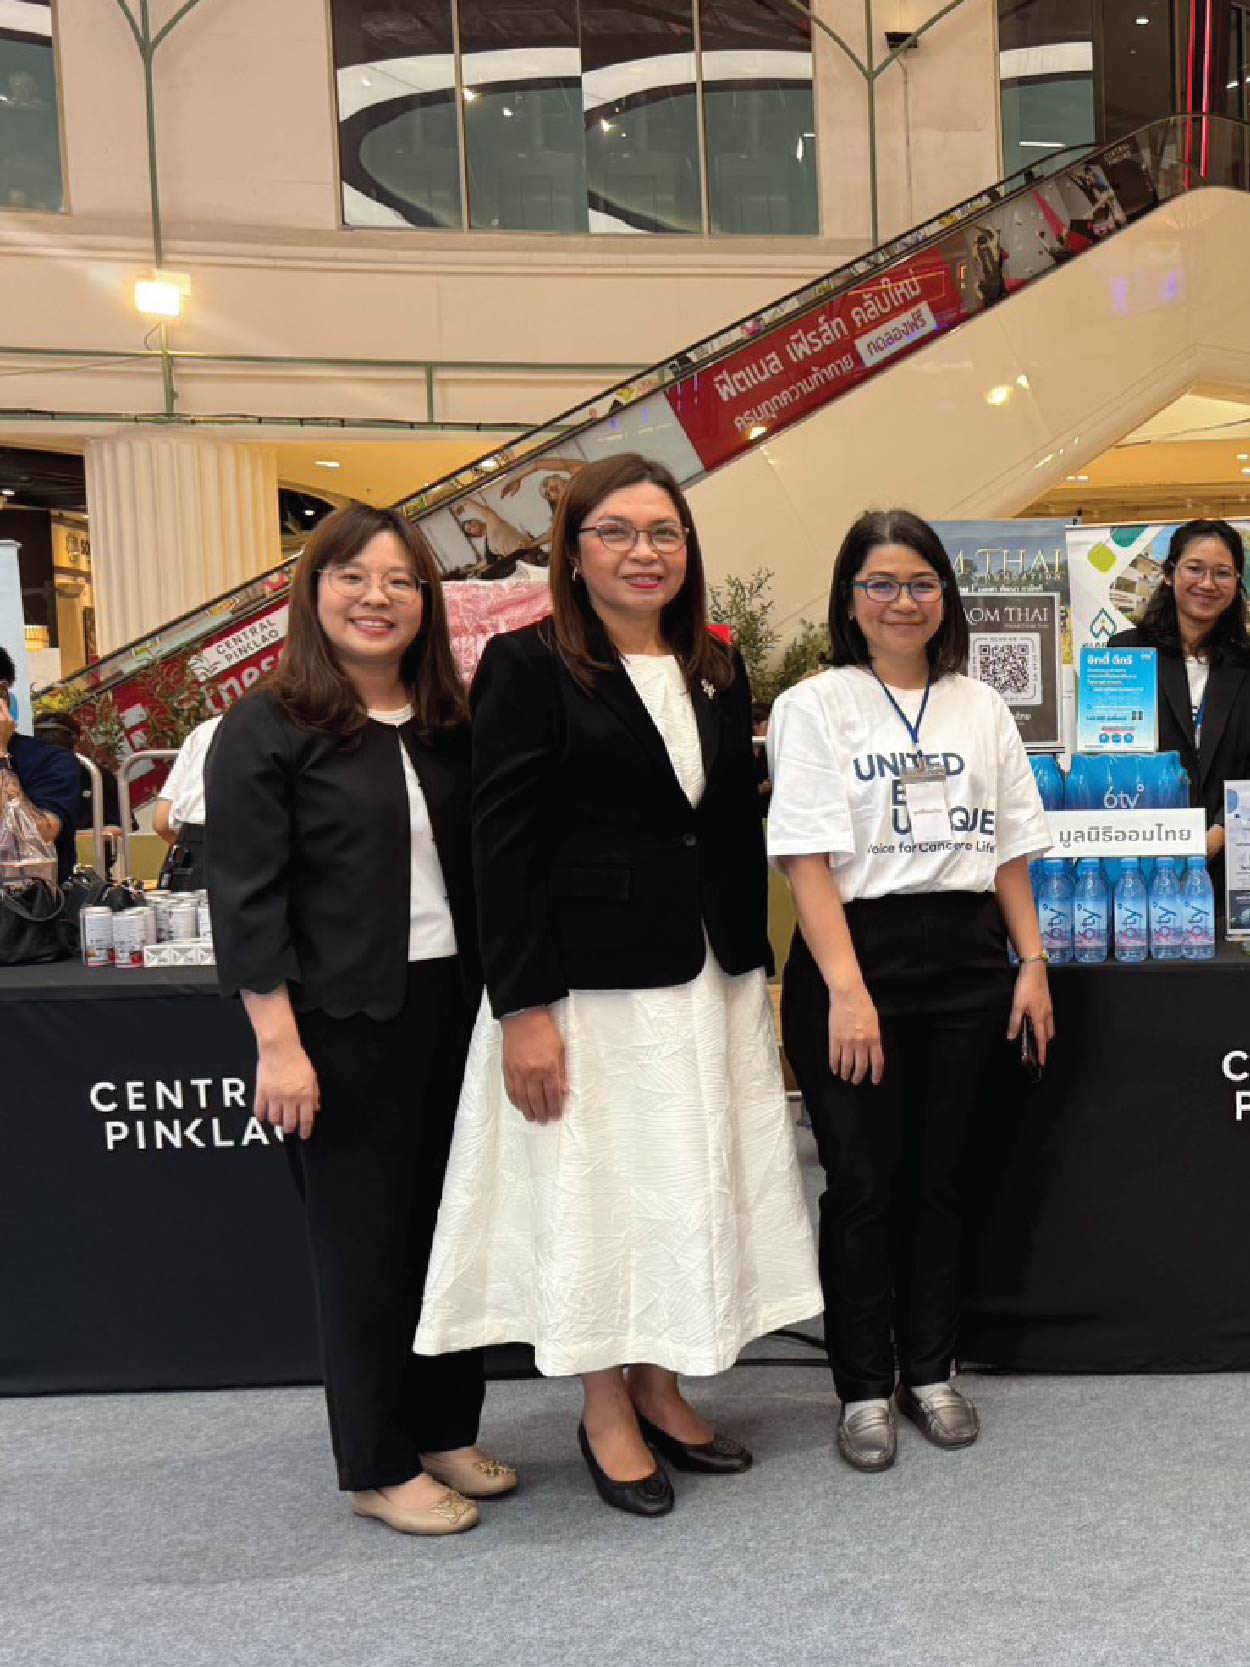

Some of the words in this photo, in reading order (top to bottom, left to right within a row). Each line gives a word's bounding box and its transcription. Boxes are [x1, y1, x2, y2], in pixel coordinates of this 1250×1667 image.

[713, 350, 784, 402] ฟิตเนส
[850, 268, 922, 328] คลับใหม่
[866, 308, 929, 358] ทดลองฟรี
[975, 548, 1062, 576] THAI
[1004, 606, 1049, 622] THAI
[216, 619, 277, 656] CENTRAL
[892, 805, 996, 835] UQUE
[1059, 823, 1192, 848] มูลนิธิออมไทย
[90, 1077, 247, 1112] CENTR
